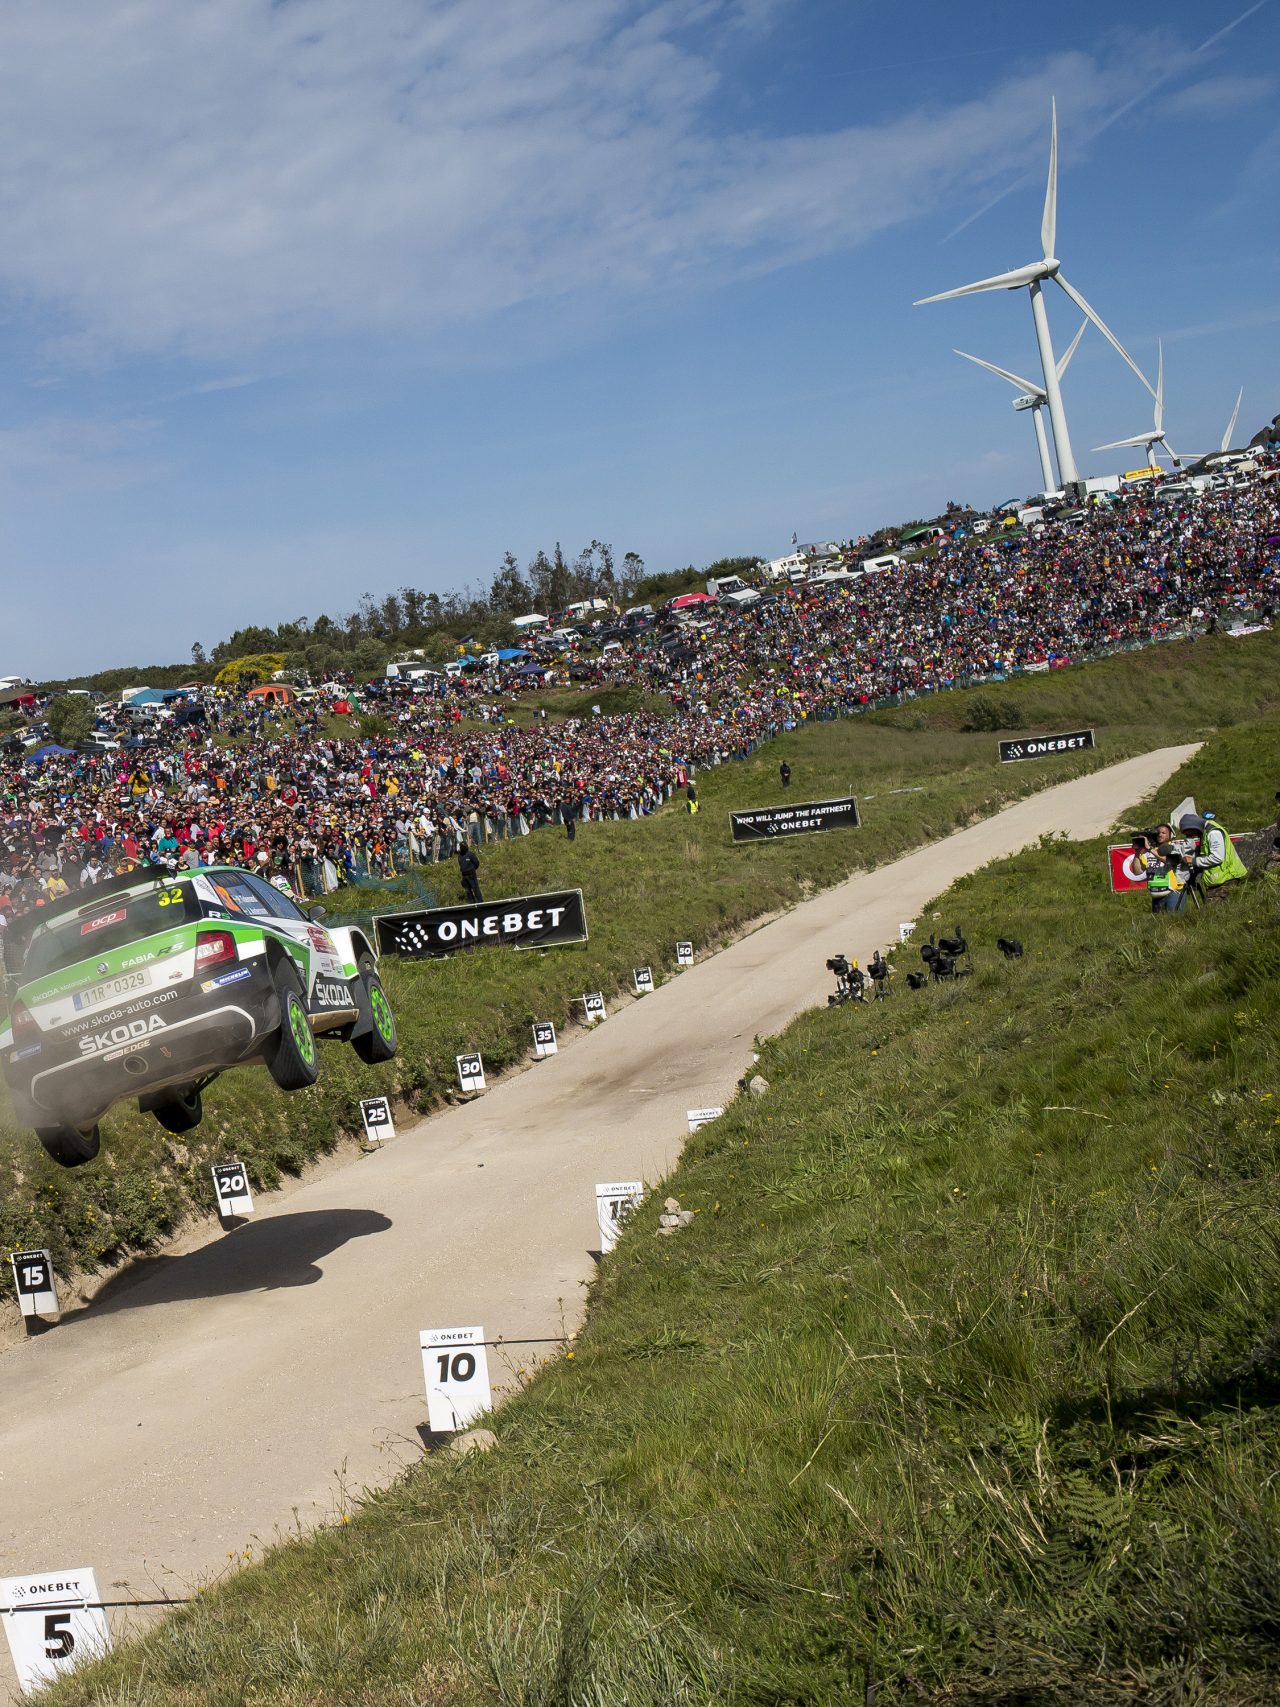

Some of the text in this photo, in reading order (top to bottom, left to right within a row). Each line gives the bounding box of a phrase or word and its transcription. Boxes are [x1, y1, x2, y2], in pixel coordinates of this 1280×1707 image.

[1027, 737, 1086, 753] ONEBET
[736, 817, 754, 825] WHO
[755, 814, 772, 822] WILL
[774, 812, 794, 820] JUMP
[811, 804, 852, 816] FARTHEST?
[781, 818, 822, 830] ONEBET
[158, 888, 184, 907] 32
[91, 913, 117, 928] acp
[437, 907, 565, 941] ONEBET
[679, 947, 691, 955] 50
[121, 952, 156, 969] FABIA
[113, 972, 146, 993] 0329
[637, 972, 650, 982] 45
[315, 978, 355, 1006] ŠKODA
[587, 998, 602, 1008] 40
[61, 989, 178, 1037] www.skoda-auto.com
[78, 1014, 167, 1056] ŠKODA
[537, 1030, 552, 1041] 35
[123, 1038, 152, 1056] EDGE
[462, 1061, 480, 1075] 30
[368, 1107, 386, 1122] 25
[220, 1175, 244, 1193] 20
[22, 1265, 44, 1286] 15
[440, 1332, 474, 1340] ONEBET
[437, 1352, 476, 1383] 10
[29, 1581, 80, 1594] ONEBET
[44, 1613, 75, 1659] 5
